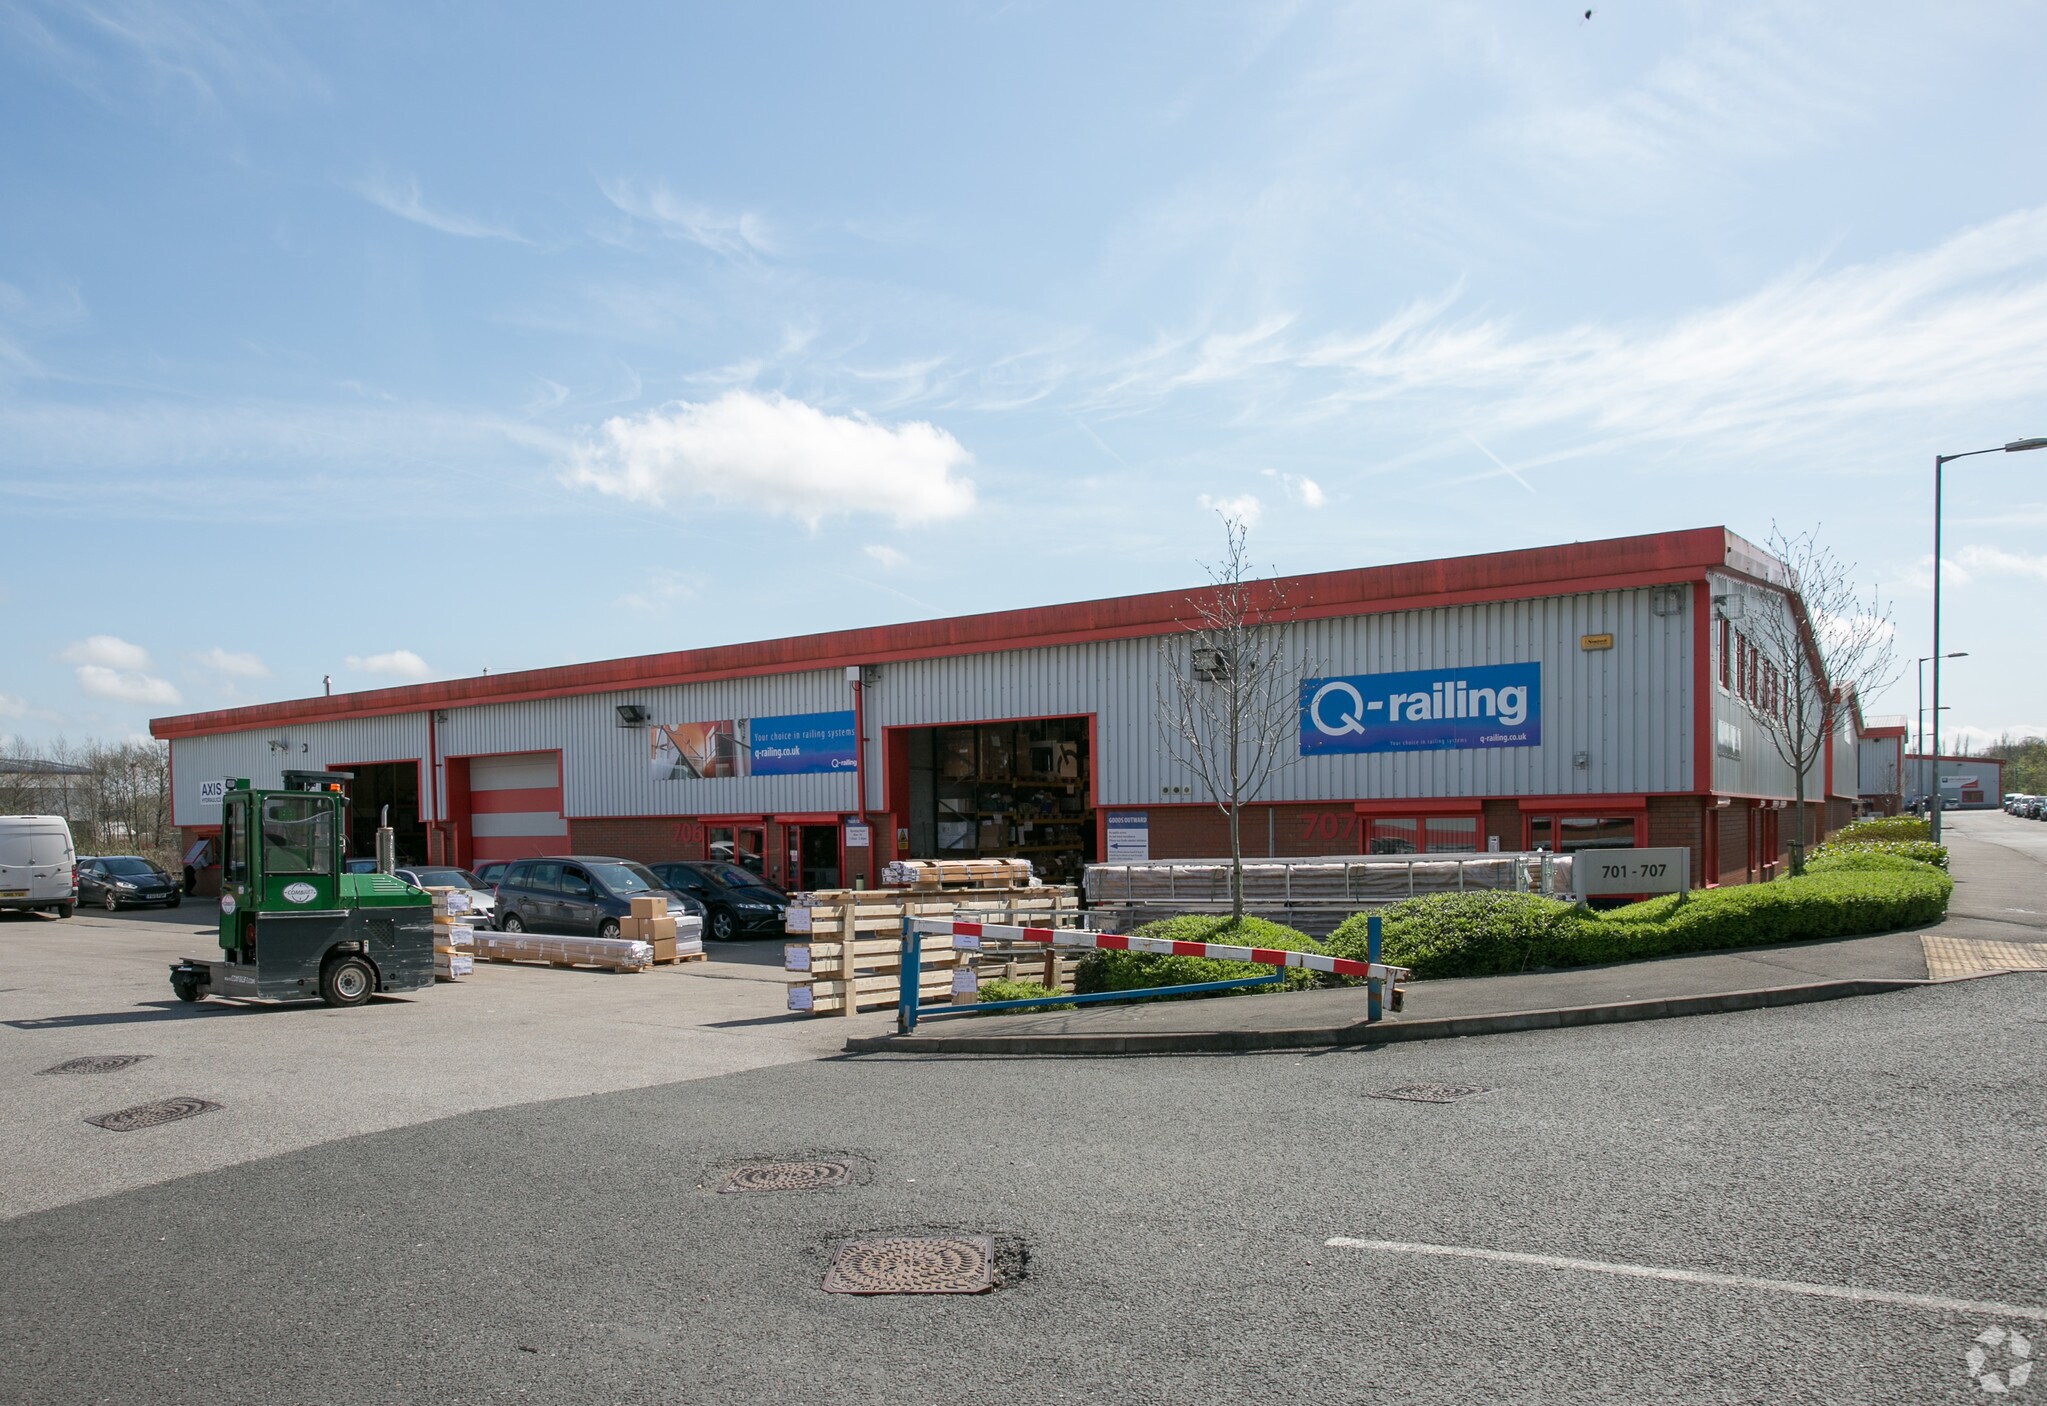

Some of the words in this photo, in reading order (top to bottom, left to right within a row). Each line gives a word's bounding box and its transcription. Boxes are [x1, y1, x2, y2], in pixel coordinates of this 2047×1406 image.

[1310, 680, 1528, 737] Q-railing
[754, 733, 768, 742] Your
[770, 732, 791, 741] choice
[793, 731, 800, 740] in
[802, 729, 825, 740] railing
[827, 728, 856, 739] systems
[1479, 732, 1527, 744] q-railing.co.uk
[754, 746, 800, 759] q-railing.co.uk
[831, 758, 858, 768] Q-railing
[201, 782, 223, 796] AXIS
[671, 822, 703, 843] 706
[1300, 812, 1357, 840] 707
[1601, 864, 1627, 879] 701
[1640, 863, 1667, 878] 707
